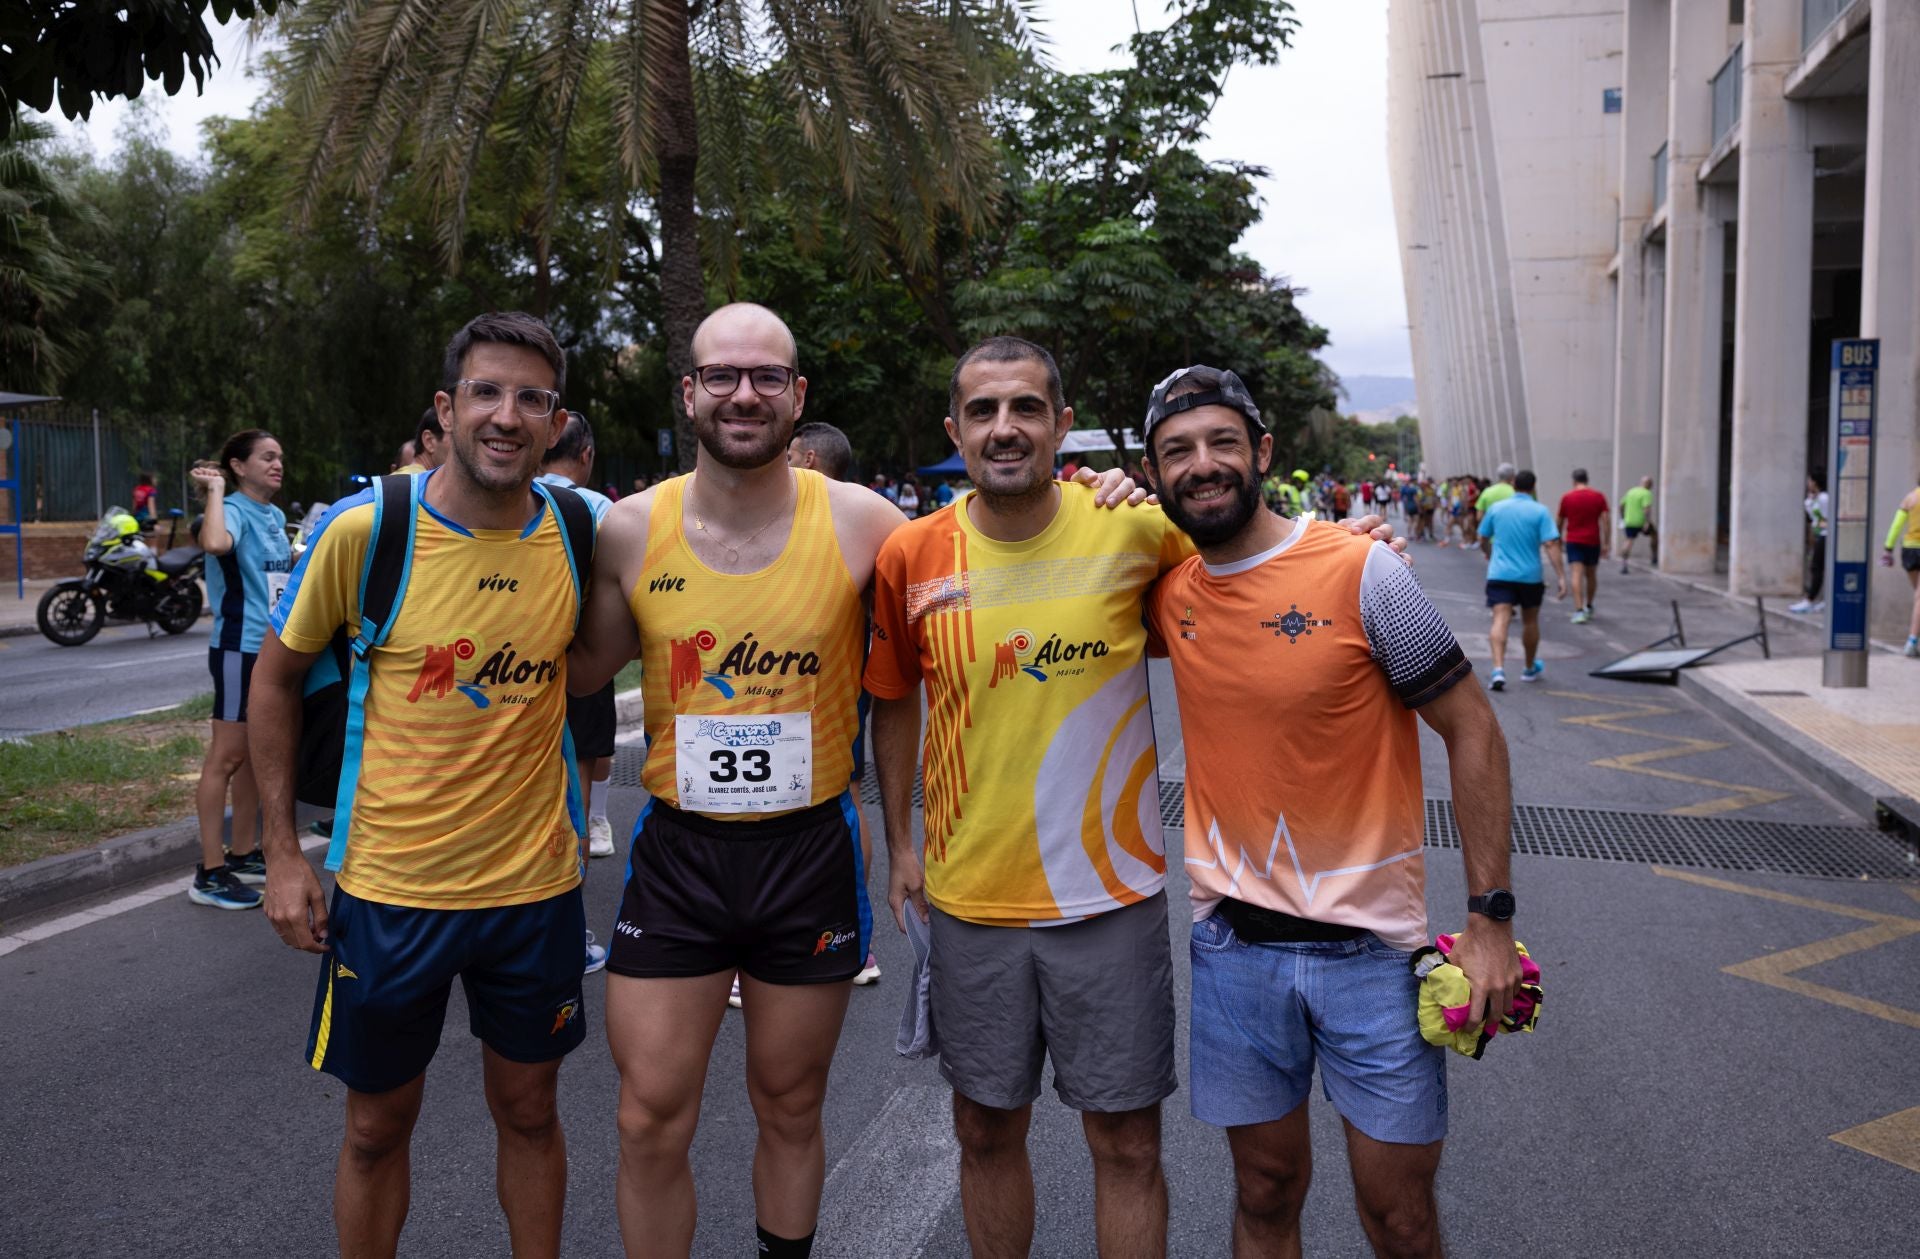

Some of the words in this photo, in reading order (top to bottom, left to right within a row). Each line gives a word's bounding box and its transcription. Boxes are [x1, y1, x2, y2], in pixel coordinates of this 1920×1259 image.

[1843, 345, 1873, 366] BUS
[1260, 621, 1280, 629] TIME
[1306, 619, 1332, 627] TRAIN
[719, 632, 822, 677] Álora
[1033, 633, 1110, 668] Álora
[1056, 667, 1085, 677] Málaga
[744, 685, 784, 698] Málaga
[500, 694, 537, 706] Málag
[713, 721, 769, 736] Carrera
[709, 749, 772, 783] 33
[831, 930, 856, 947] Álora
